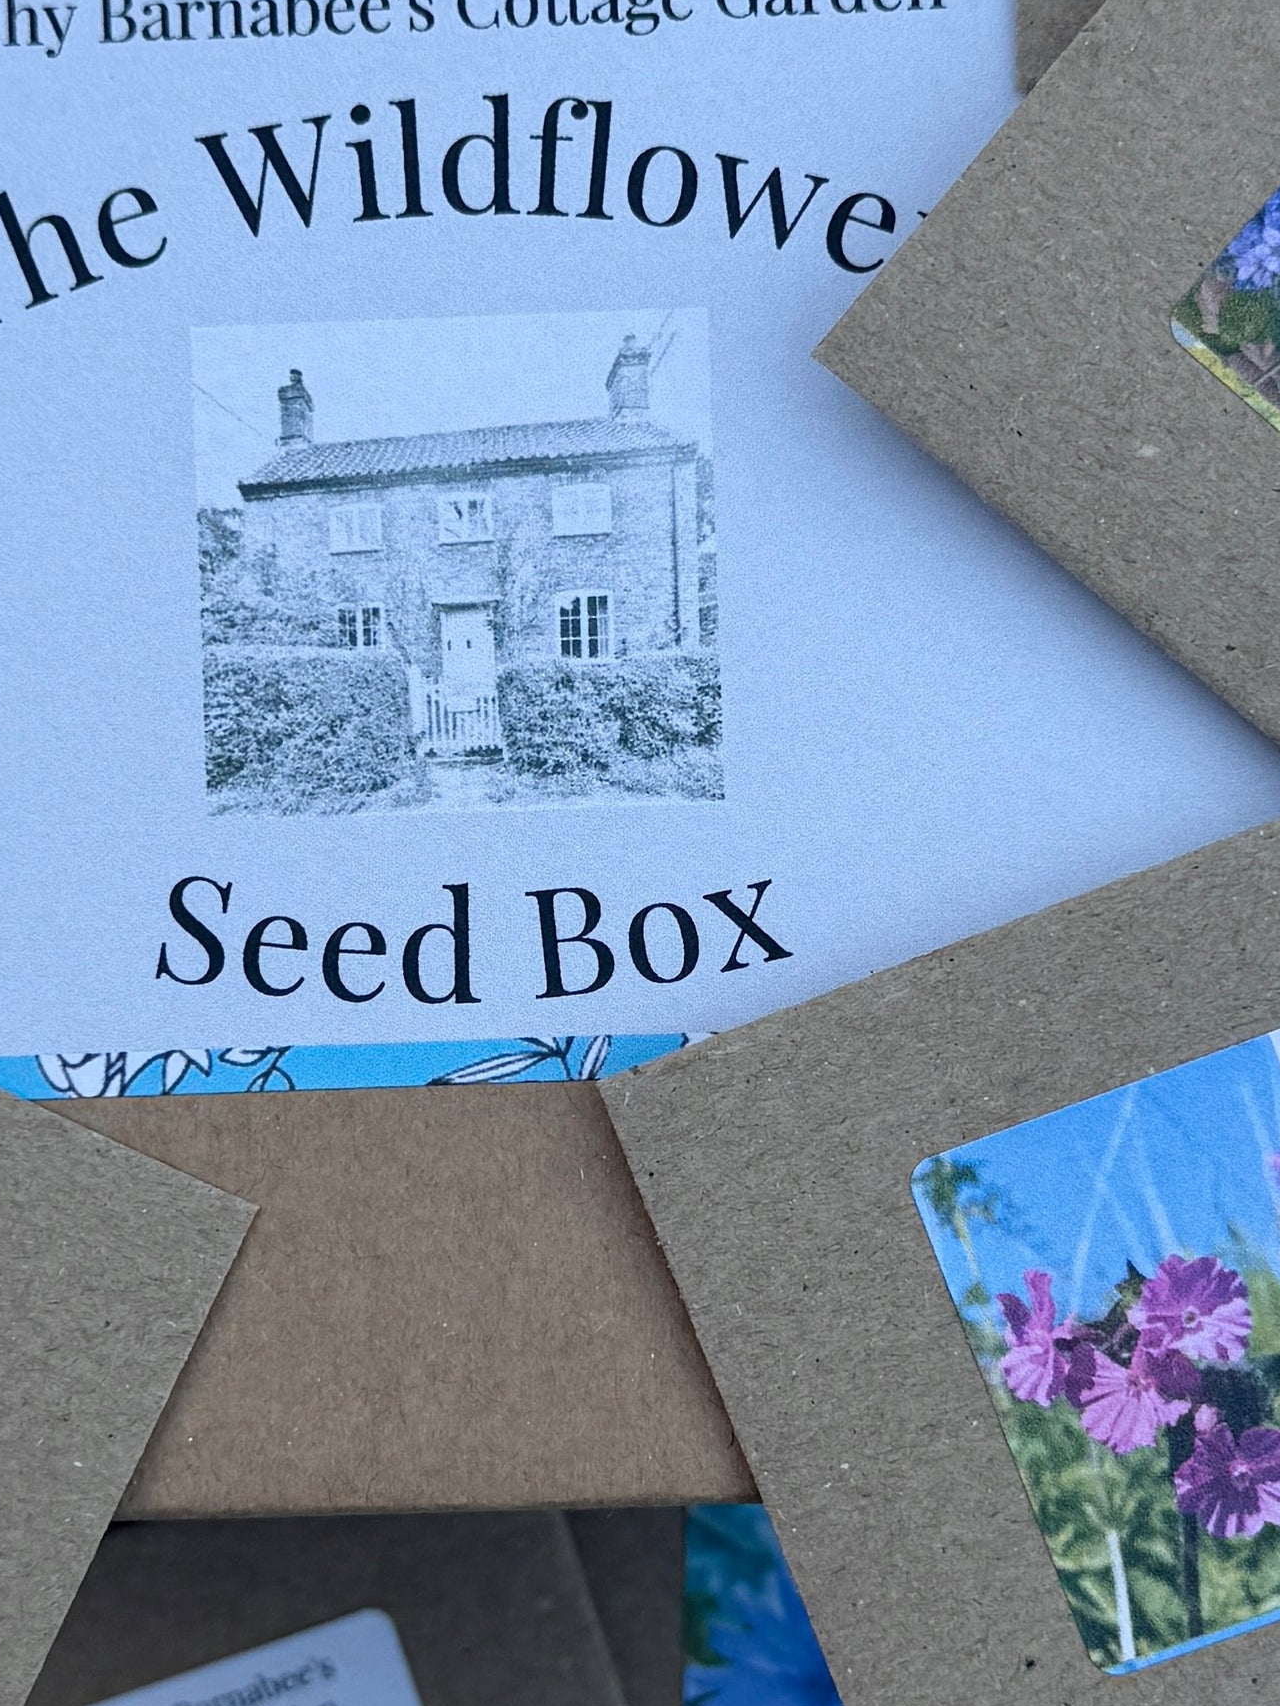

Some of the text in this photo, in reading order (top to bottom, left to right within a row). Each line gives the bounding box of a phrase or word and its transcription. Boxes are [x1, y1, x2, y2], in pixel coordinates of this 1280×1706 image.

[195, 93, 928, 276] Wildflowe
[155, 876, 794, 1005] Seed Box
